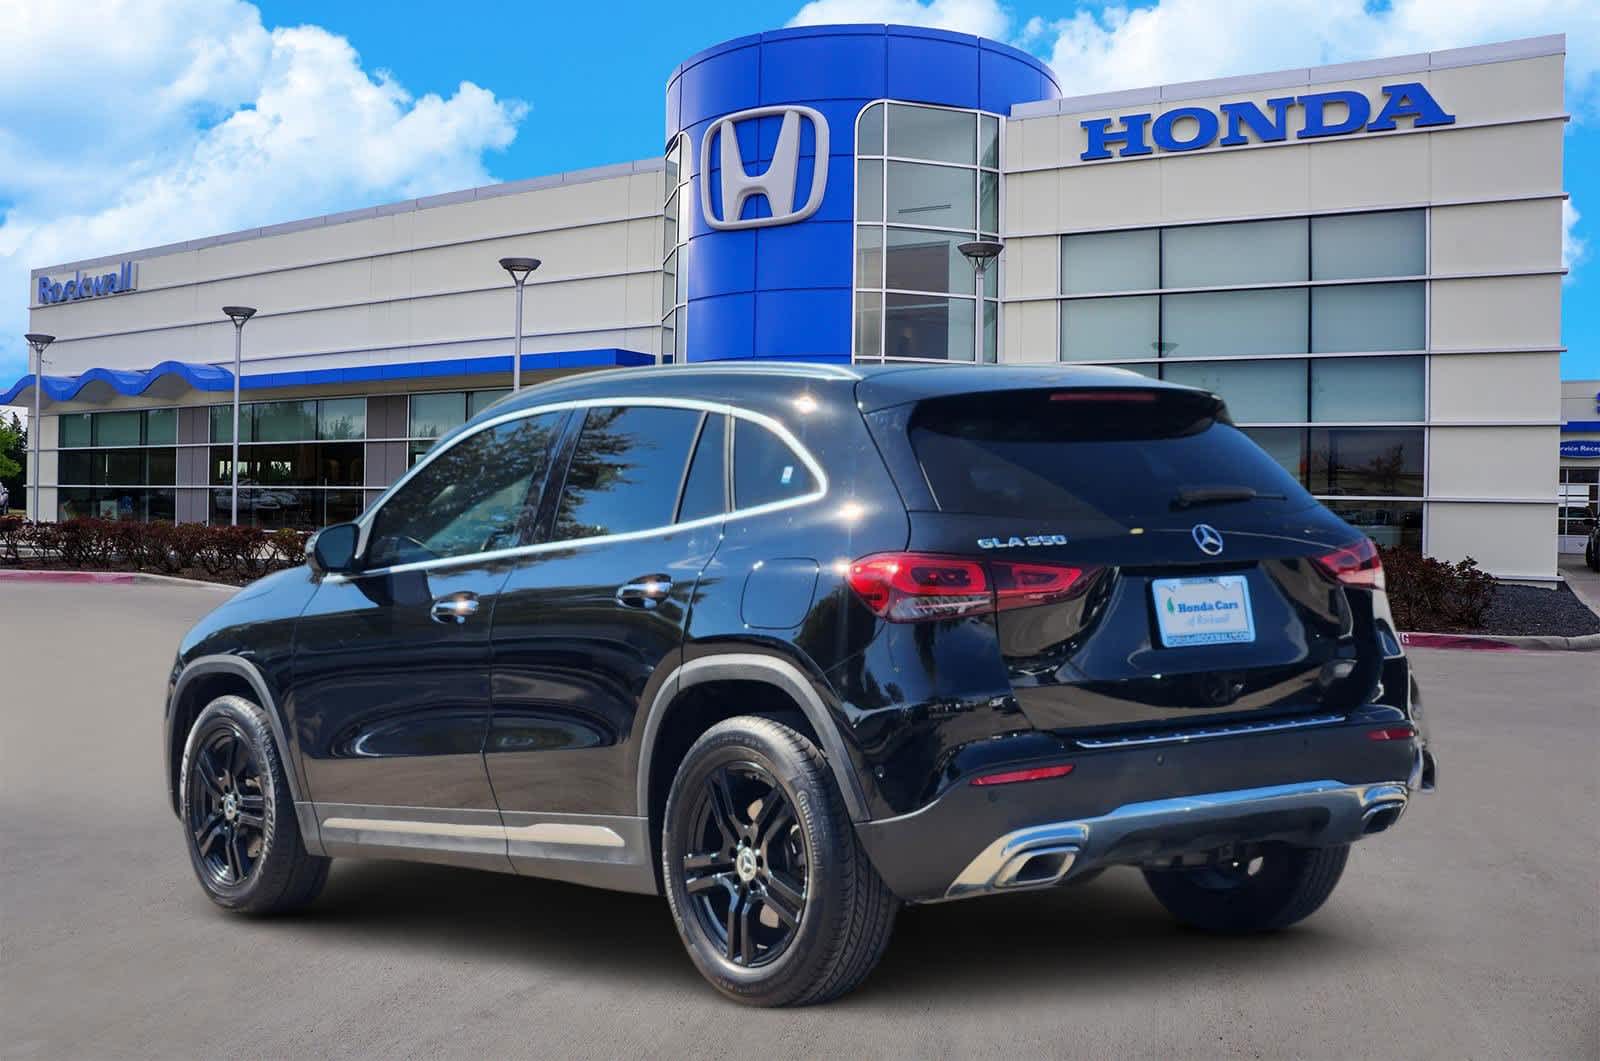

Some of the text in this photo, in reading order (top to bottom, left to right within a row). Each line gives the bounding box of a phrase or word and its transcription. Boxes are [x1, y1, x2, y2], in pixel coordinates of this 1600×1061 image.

[1080, 82, 1456, 161] HONDA
[38, 260, 133, 304] Rockwell
[977, 537, 1025, 549] GLA
[1177, 600, 1239, 613] Honda Cars
